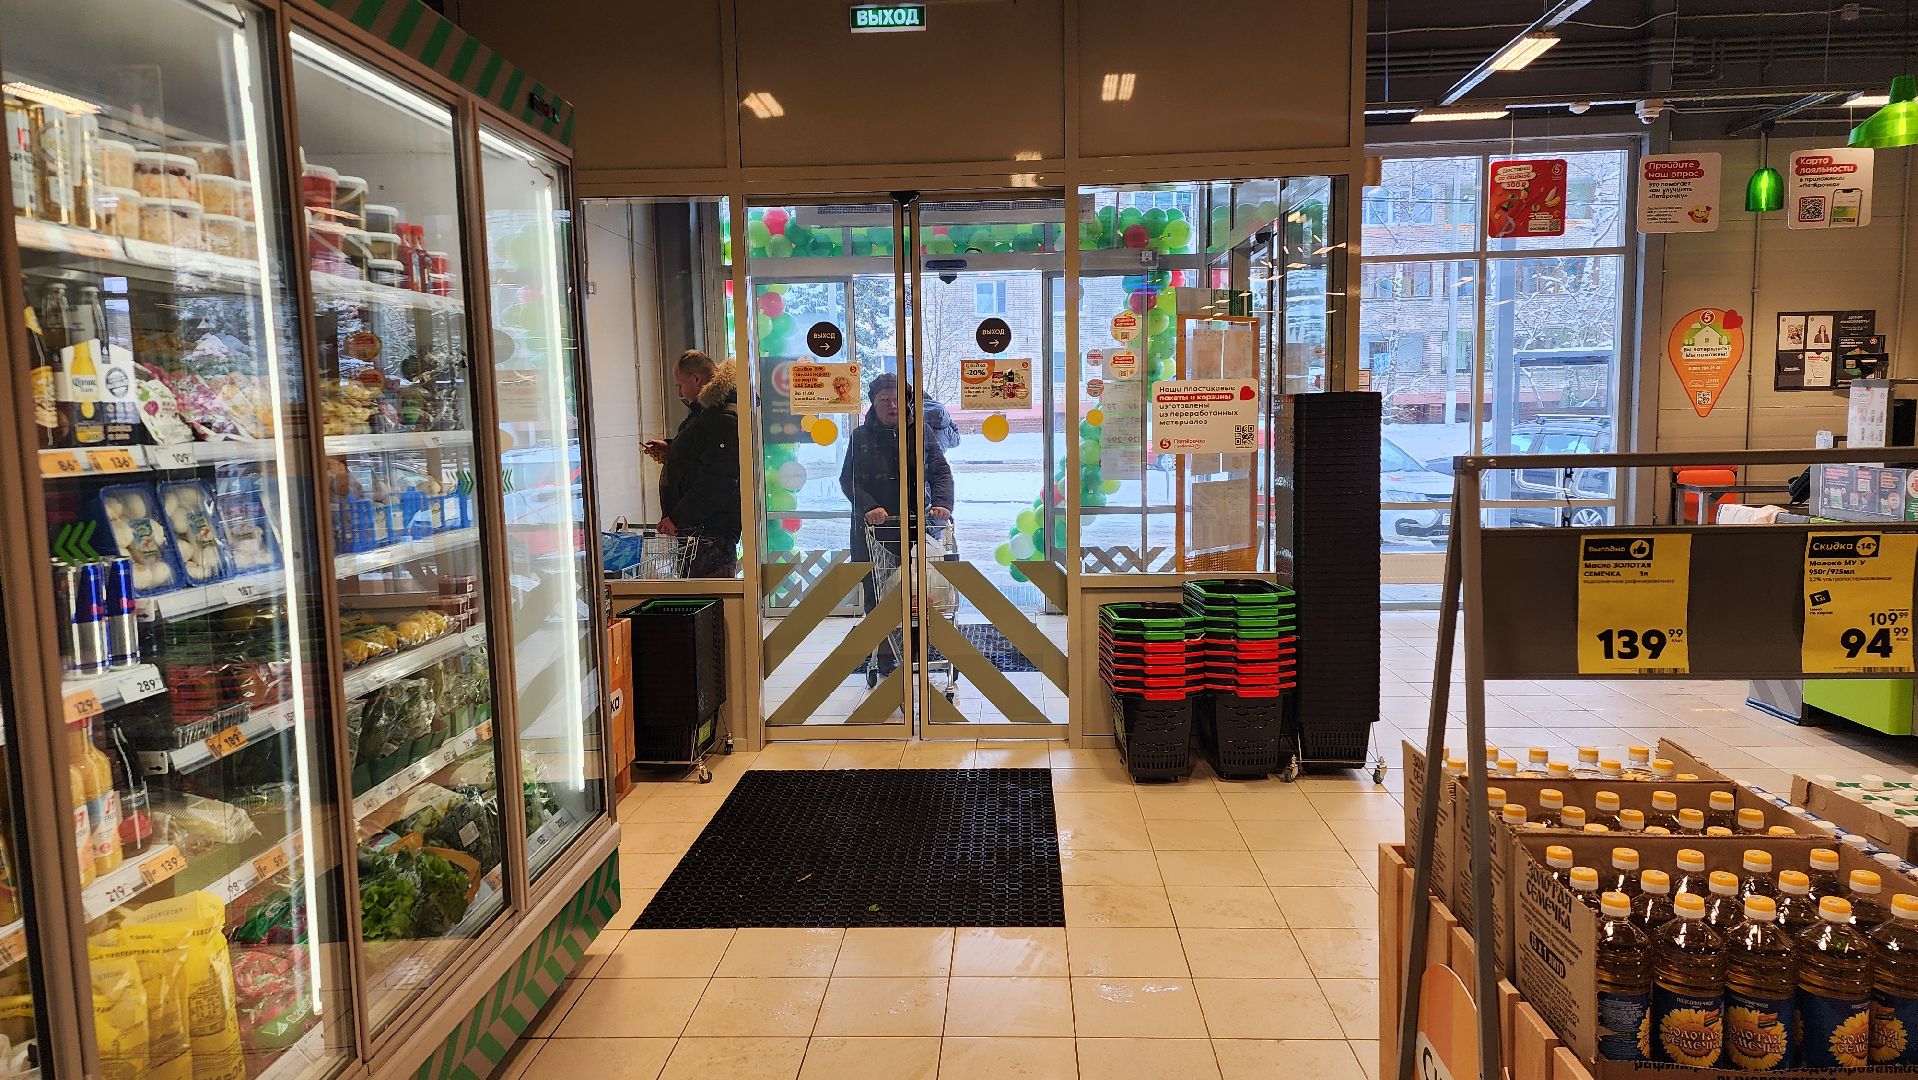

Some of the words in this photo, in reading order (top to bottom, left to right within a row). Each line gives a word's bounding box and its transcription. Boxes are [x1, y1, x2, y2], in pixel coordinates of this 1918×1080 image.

[857, 9, 919, 25] ВЫХОД
[1649, 162, 1695, 170] Пройдите
[1800, 157, 1829, 166] Карта
[1800, 165, 1854, 174] лояльности
[1169, 410, 1239, 418] переработанных
[1813, 542, 1853, 551] Скидка
[1809, 568, 1855, 576] 950г/925мл
[1869, 612, 1898, 626] 109
[1597, 629, 1667, 660] 139
[1668, 629, 1684, 638] 99
[1840, 628, 1893, 658] 94
[1893, 627, 1909, 636] 99
[136, 679, 156, 693] 289
[160, 857, 178, 872] 139
[105, 885, 126, 902] 219
[1527, 860, 1572, 914] ЗОЛОТАЯ
[1526, 879, 1572, 934] СЕМЕЧКА
[1729, 1024, 1781, 1044] ОЛОТАЯ
